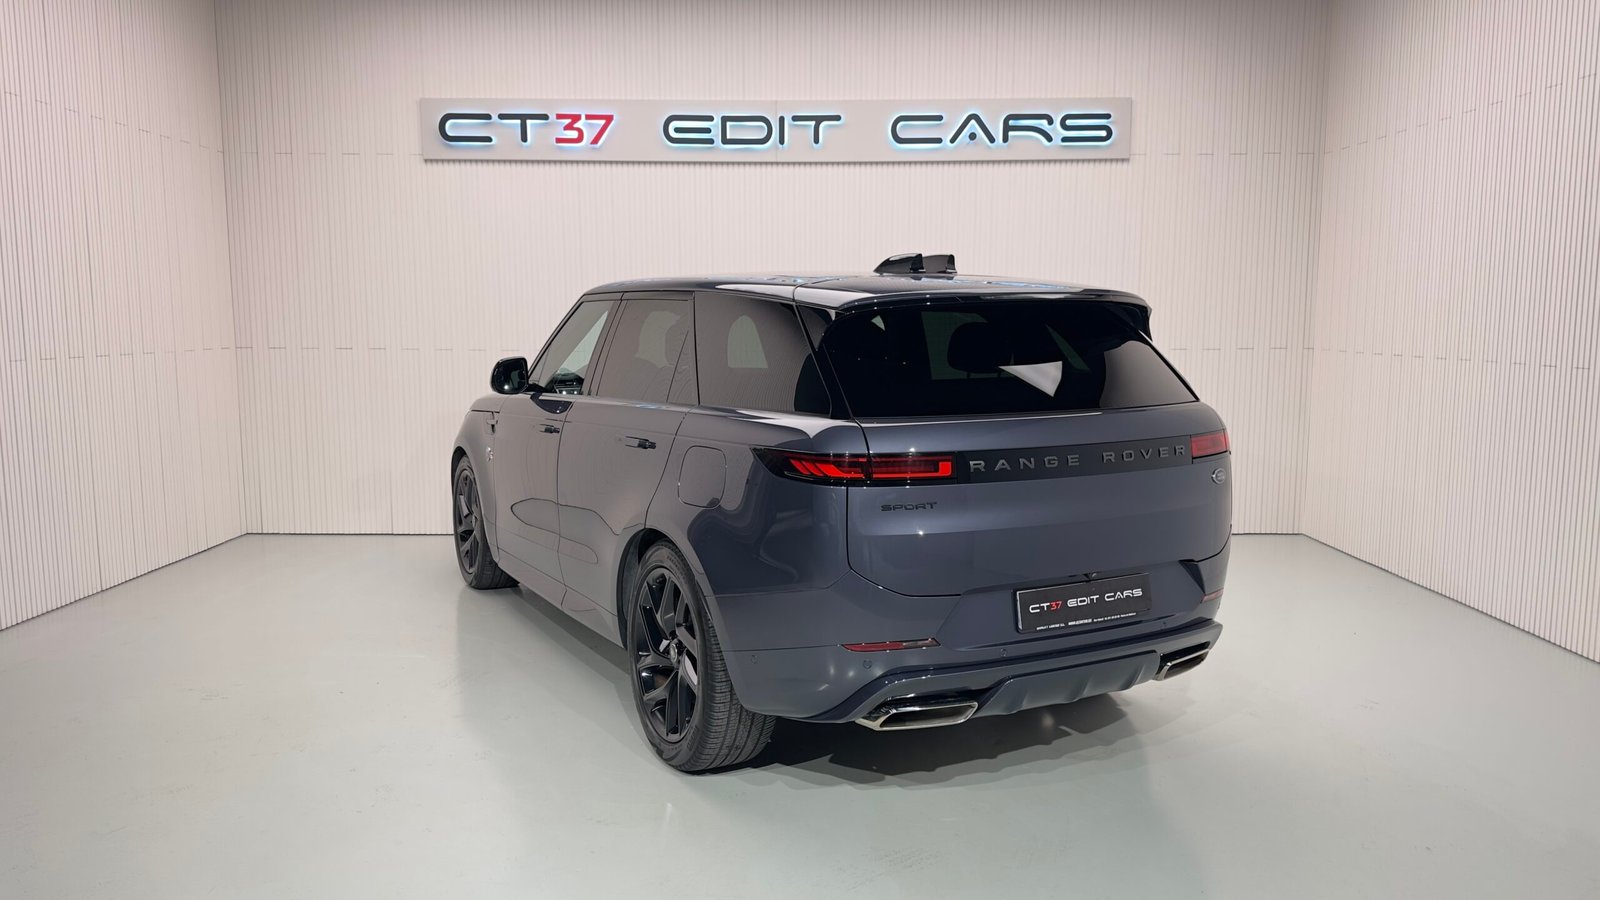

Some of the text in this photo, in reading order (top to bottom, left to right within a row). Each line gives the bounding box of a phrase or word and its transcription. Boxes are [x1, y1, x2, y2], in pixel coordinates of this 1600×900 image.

[437, 112, 1114, 146] CT37 EDIT CARS
[969, 444, 1186, 473] RANGE ROVER
[880, 501, 938, 512] SPORT
[1029, 588, 1143, 613] CT37 EDIT CARS
